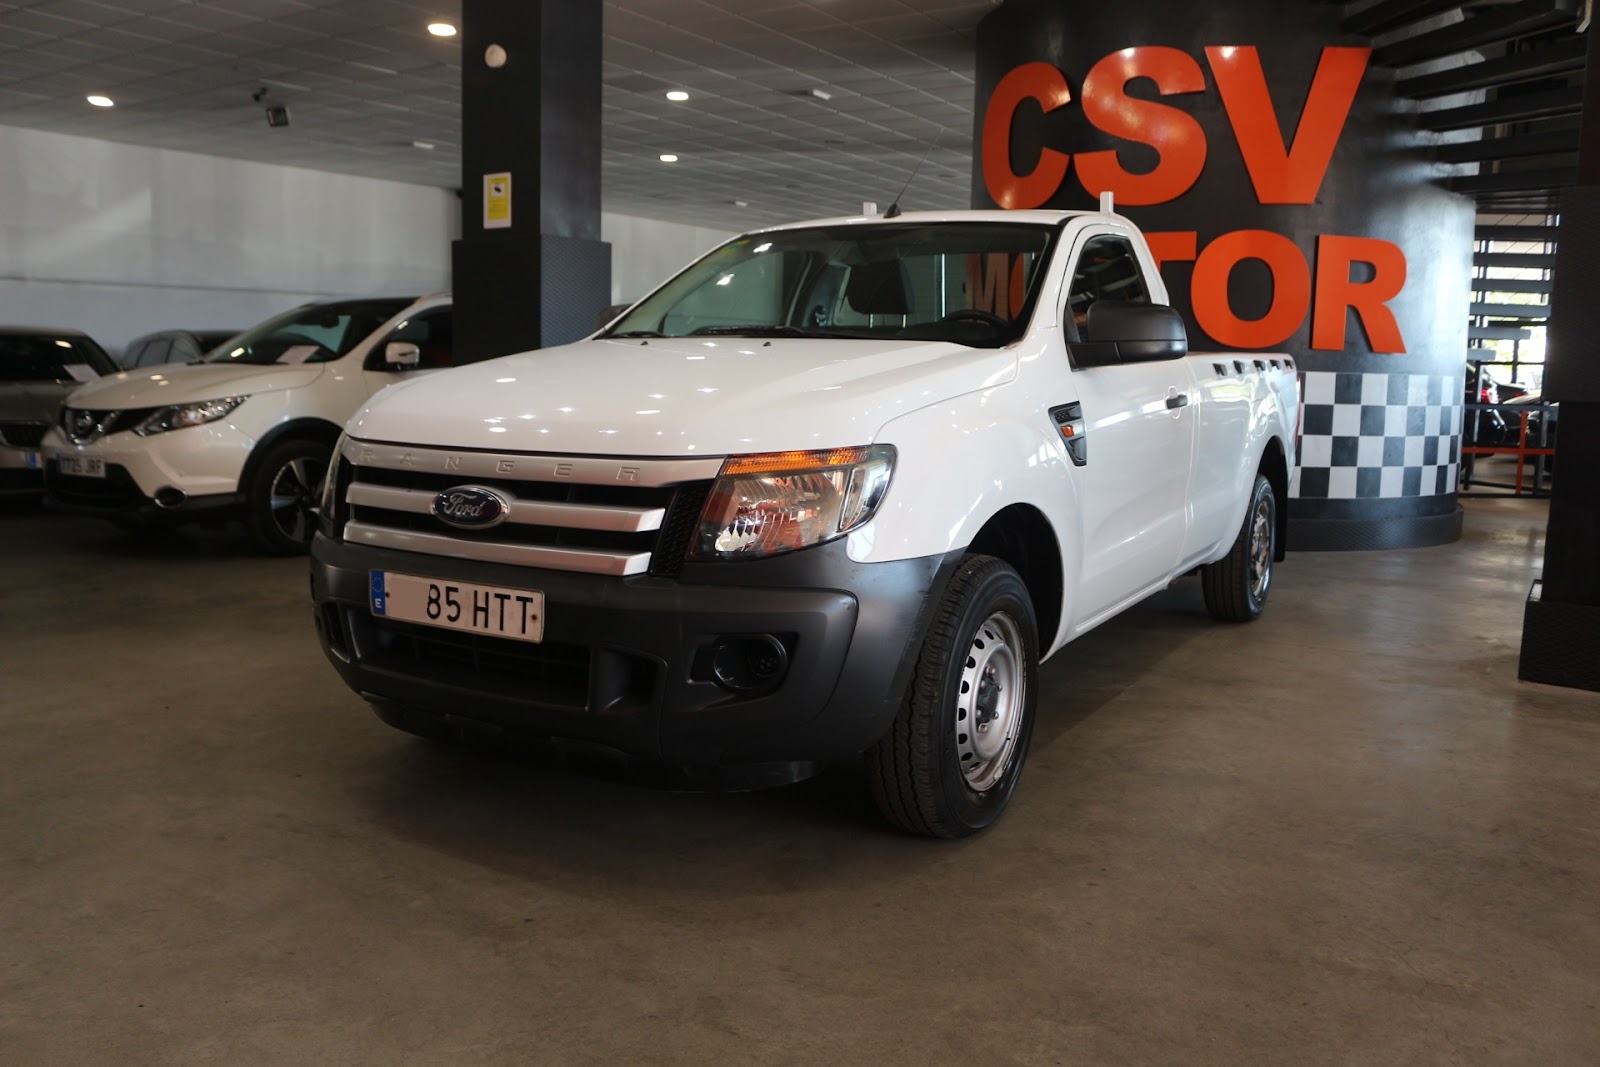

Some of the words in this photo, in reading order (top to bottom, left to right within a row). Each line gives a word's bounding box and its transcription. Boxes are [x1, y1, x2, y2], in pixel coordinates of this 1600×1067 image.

[981, 45, 1373, 210] CSV
[967, 229, 1407, 354] MOR
[359, 449, 640, 481] RANGER
[444, 492, 486, 517] Ford
[473, 590, 533, 634] HTT
